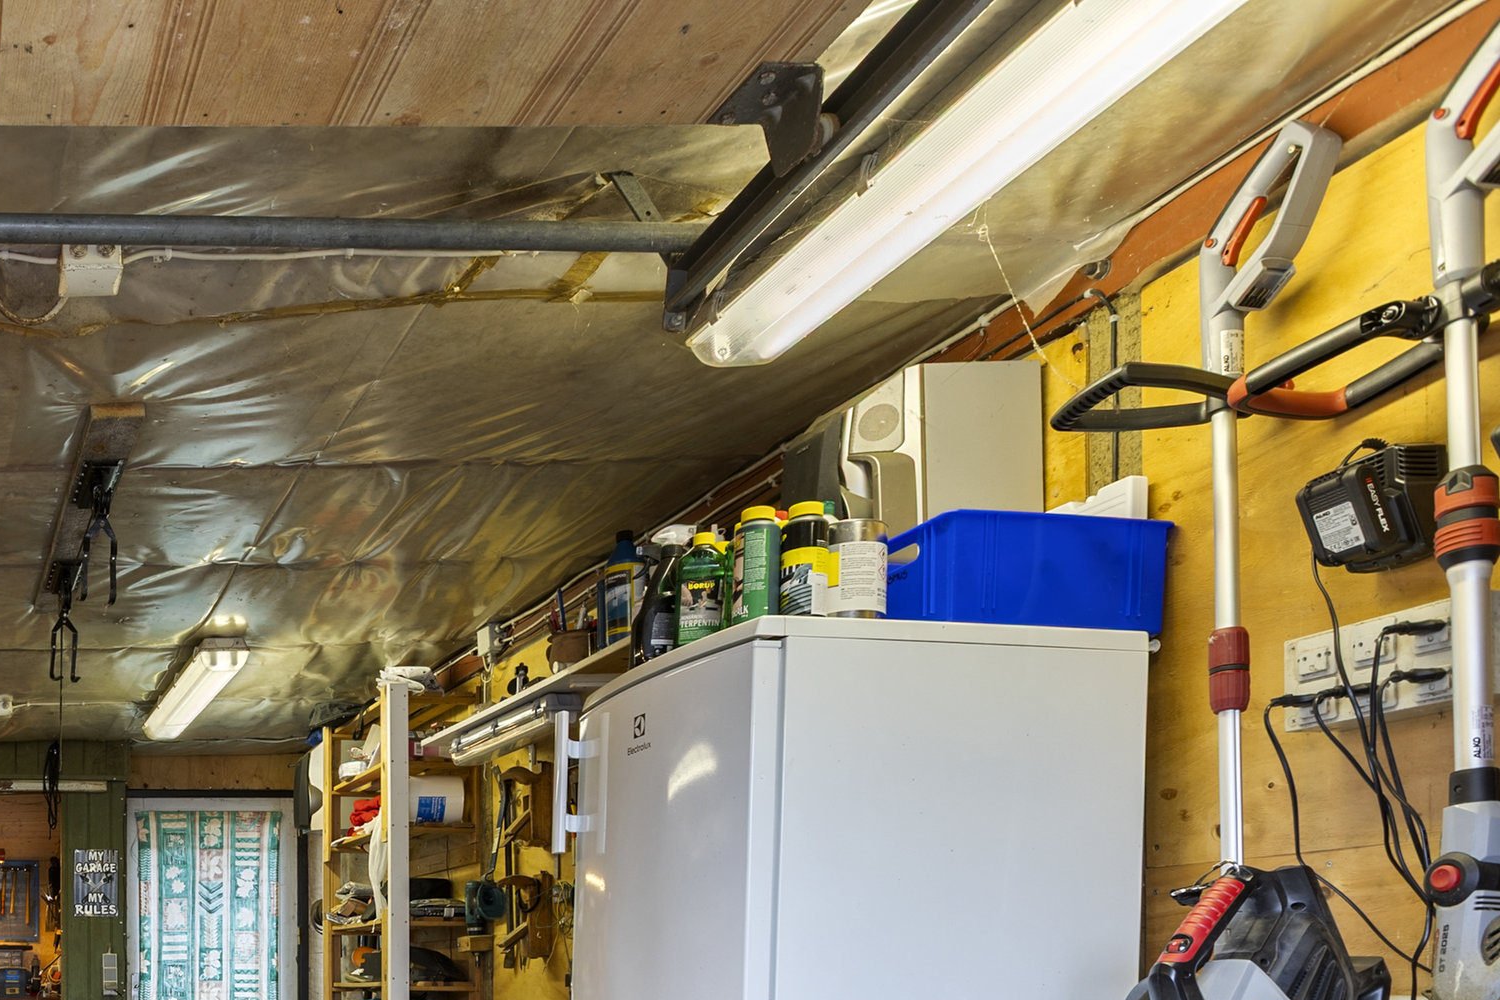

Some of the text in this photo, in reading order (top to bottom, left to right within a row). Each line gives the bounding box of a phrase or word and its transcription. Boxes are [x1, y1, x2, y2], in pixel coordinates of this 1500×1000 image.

[1366, 483, 1390, 533] EASY FLEX
[688, 582, 716, 590] BORUP
[681, 619, 720, 628] TERPENTIN
[88, 851, 104, 861] MY
[75, 862, 117, 873] GARAGE
[88, 892, 104, 903] MY
[74, 904, 117, 915] RULES
